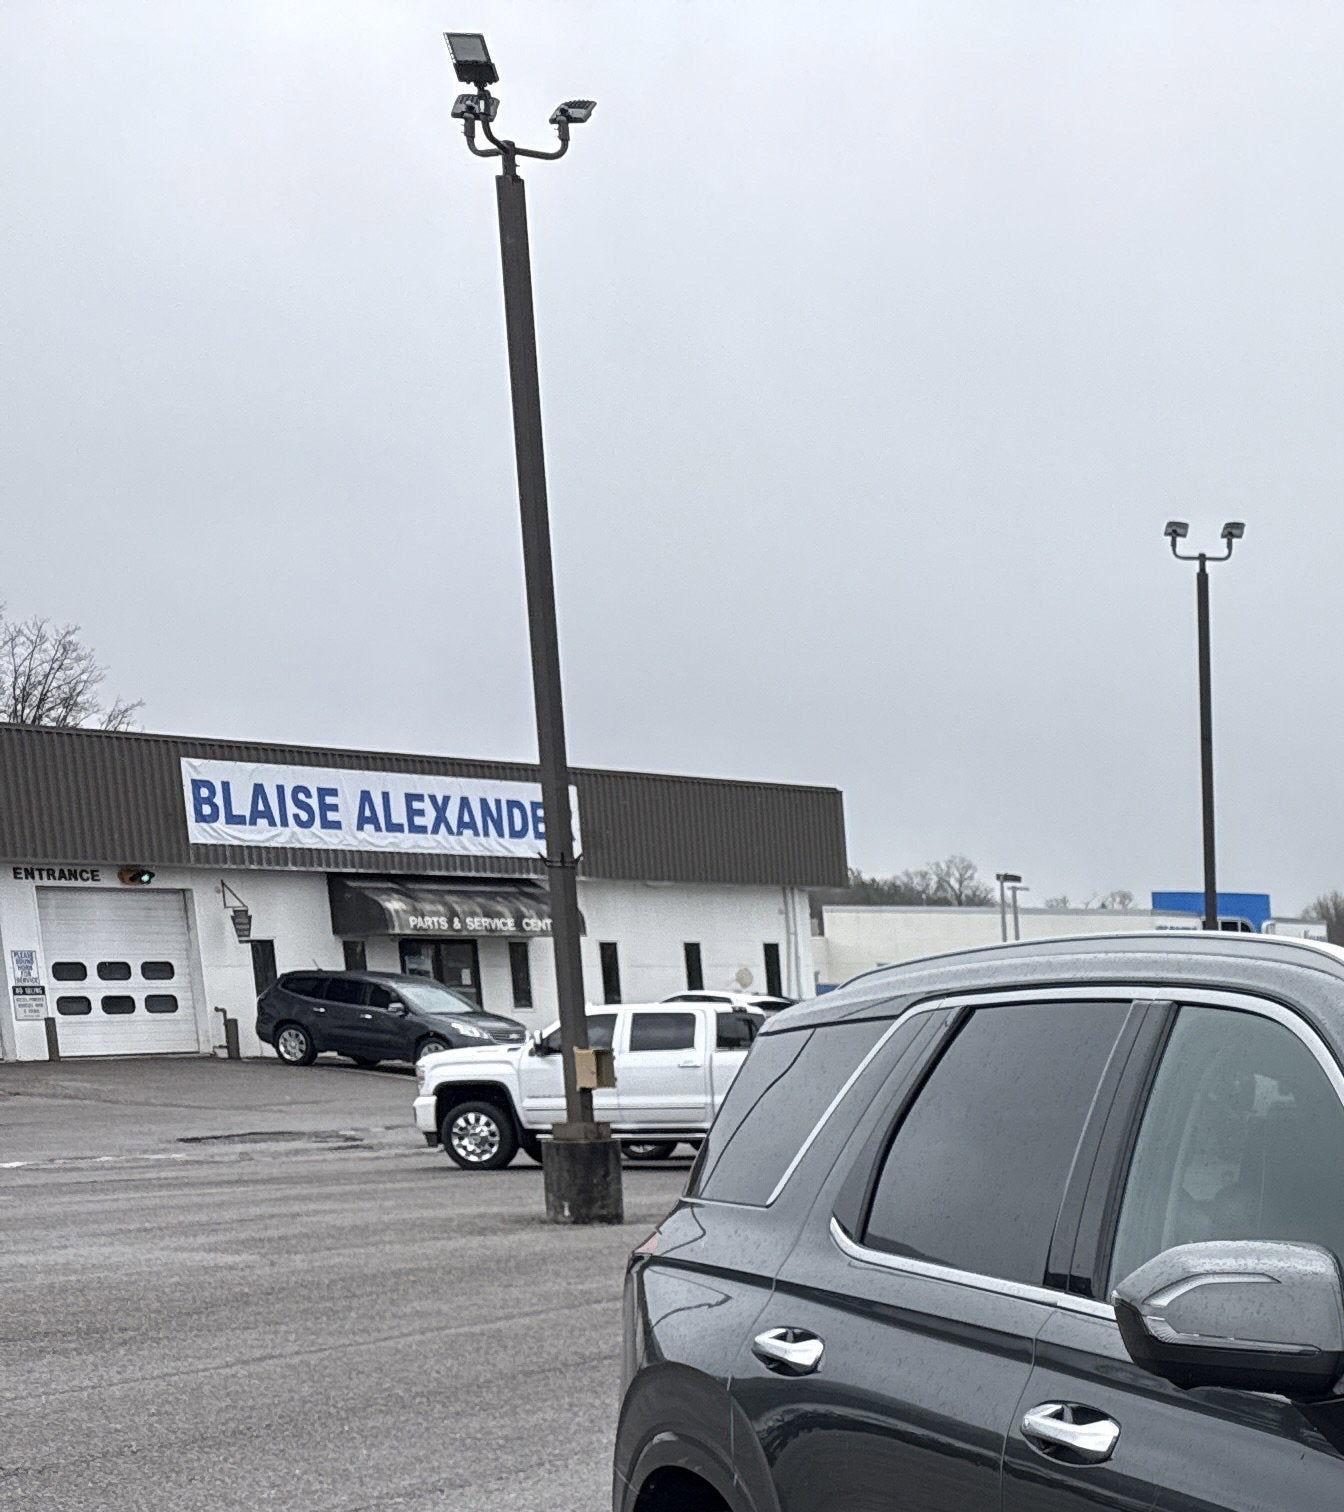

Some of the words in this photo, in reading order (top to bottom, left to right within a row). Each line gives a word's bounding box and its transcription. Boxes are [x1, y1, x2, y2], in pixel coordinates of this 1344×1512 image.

[191, 778, 342, 830] BLAISE
[356, 790, 547, 840] ALEXANDE
[12, 867, 101, 882] ENTRANCE
[408, 916, 448, 930] PARTS
[453, 917, 461, 930] &
[465, 917, 516, 931] SERVICE
[522, 918, 552, 931] CENT
